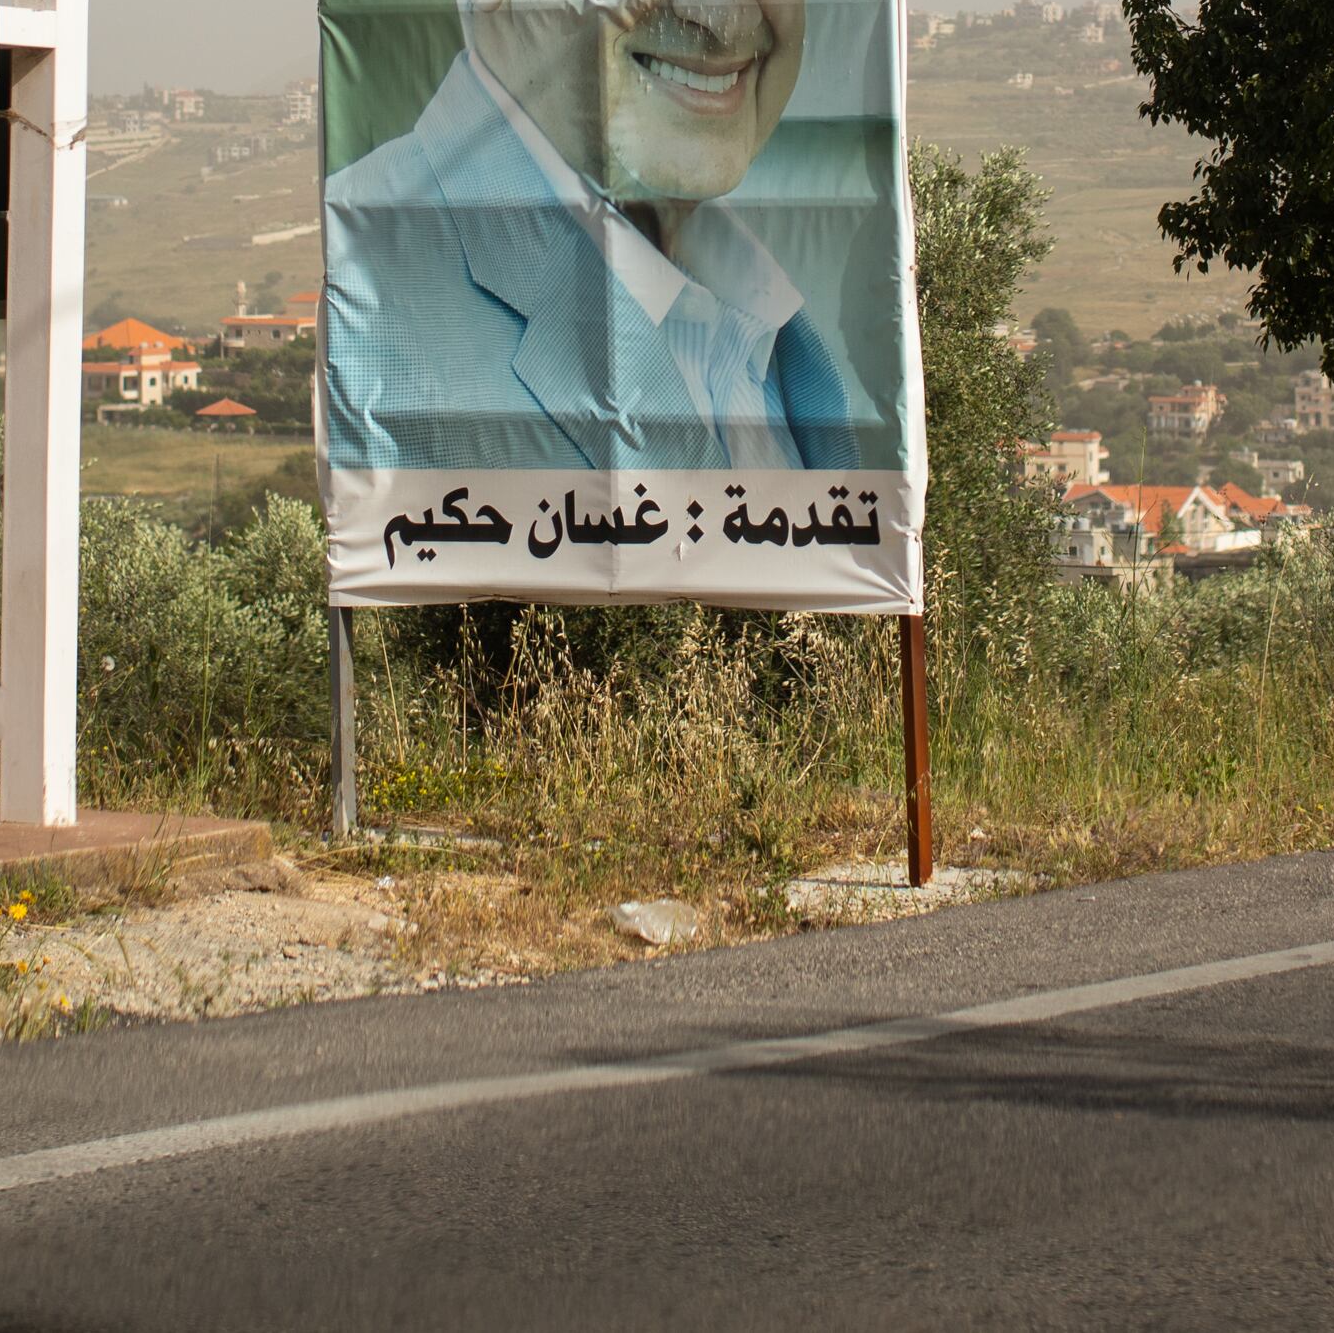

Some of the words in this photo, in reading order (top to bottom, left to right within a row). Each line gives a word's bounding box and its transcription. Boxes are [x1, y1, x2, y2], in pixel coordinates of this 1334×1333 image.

[383, 487, 513, 569] حكيم
[527, 483, 669, 559] غسان
[722, 484, 881, 547] تقدمة
